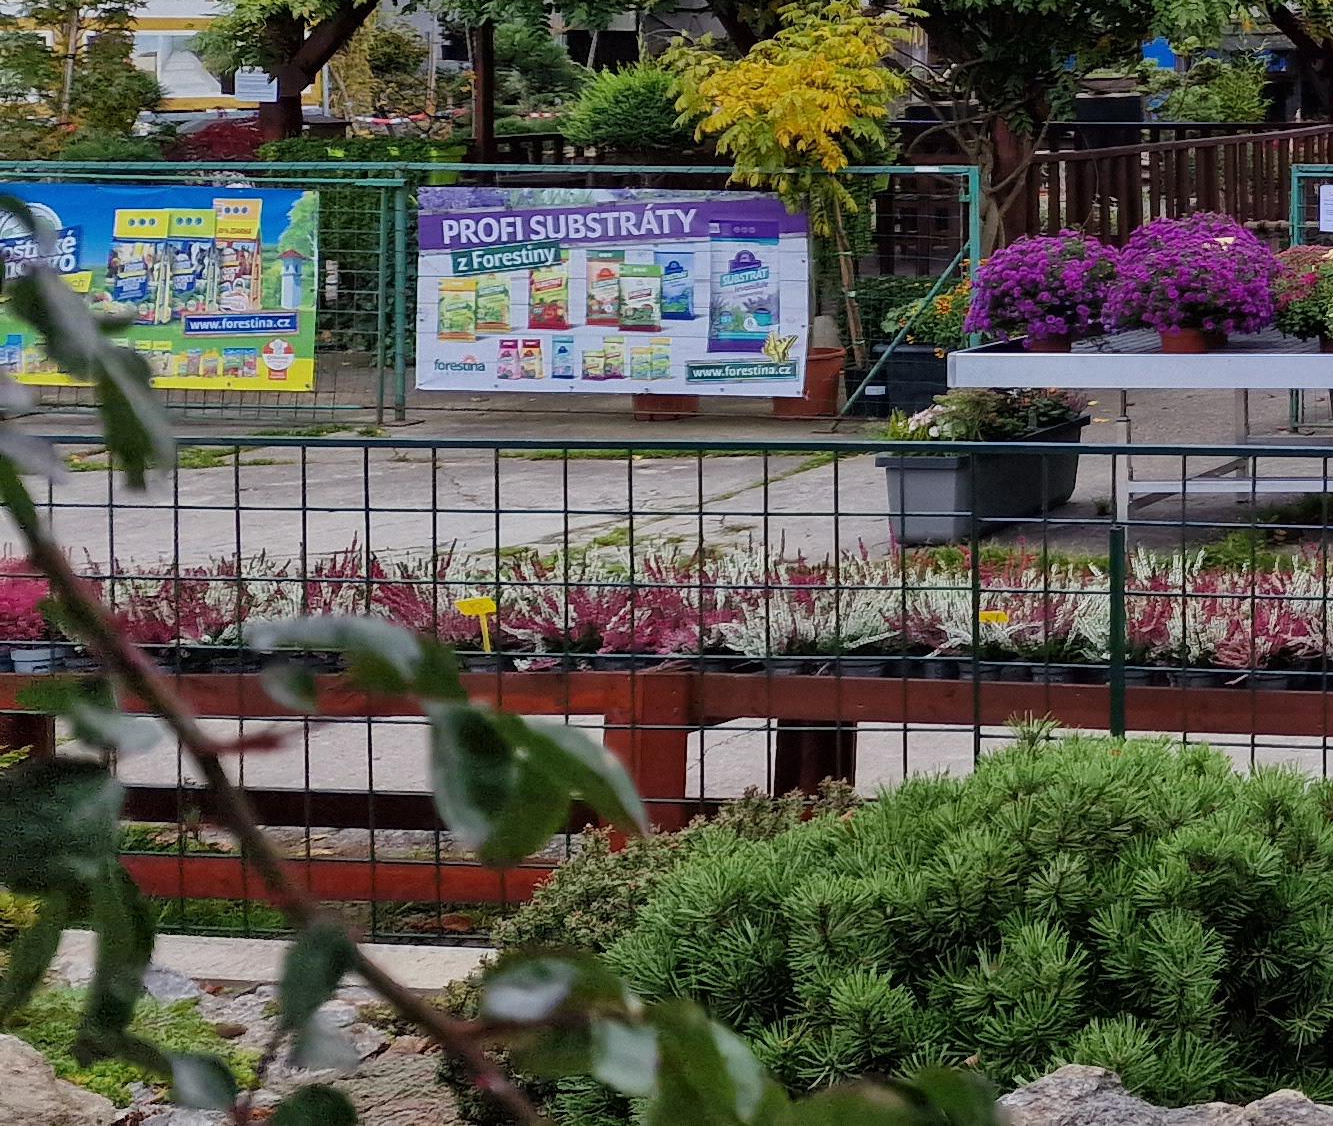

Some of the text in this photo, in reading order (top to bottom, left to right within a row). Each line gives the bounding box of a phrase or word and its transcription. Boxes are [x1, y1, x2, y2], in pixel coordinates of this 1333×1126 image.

[442, 203, 697, 244] PROFI SUBSTRÁTY
[457, 245, 556, 271] z Forestiny
[190, 317, 291, 330] www.forestina.cz
[433, 358, 486, 372] forestina
[692, 364, 792, 378] www.forestina.cz
